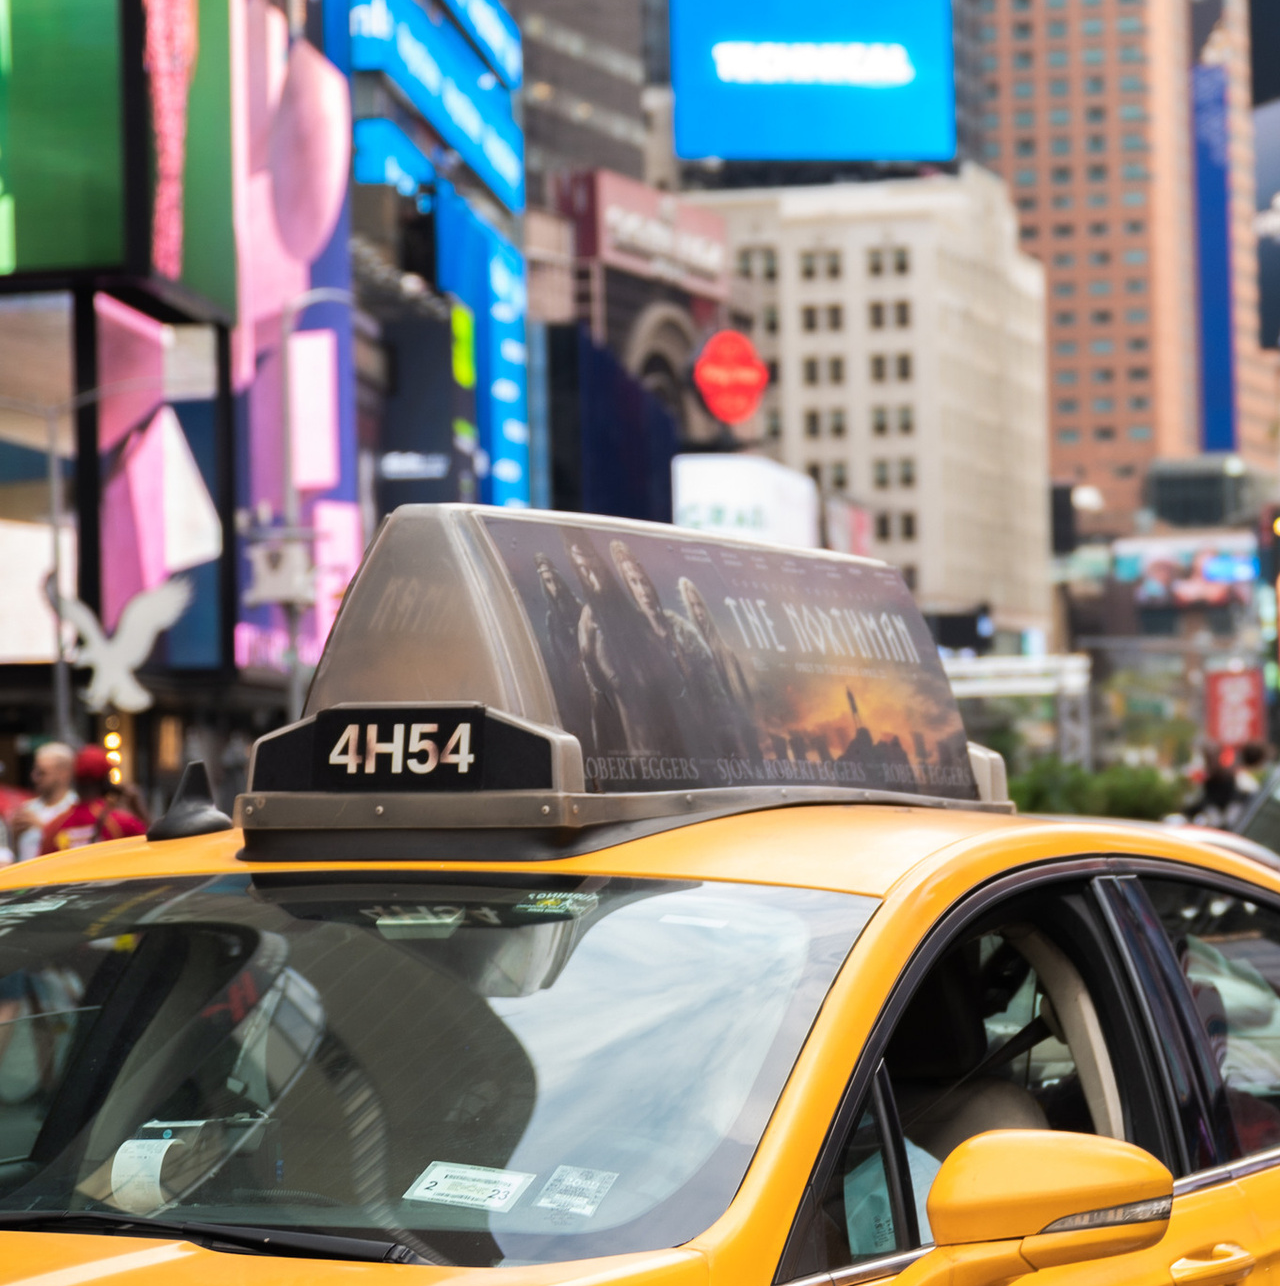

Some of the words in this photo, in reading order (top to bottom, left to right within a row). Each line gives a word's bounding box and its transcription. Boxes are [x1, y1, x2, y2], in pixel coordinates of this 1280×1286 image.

[724, 596, 787, 653] THE
[782, 601, 921, 664] NORTHMAN
[328, 722, 475, 775] 4H54
[584, 756, 637, 780] OBERT
[640, 756, 701, 780] EGGERS
[817, 760, 867, 783] EGGERS
[423, 1180, 438, 1192] 2
[487, 1188, 511, 1201] 23
